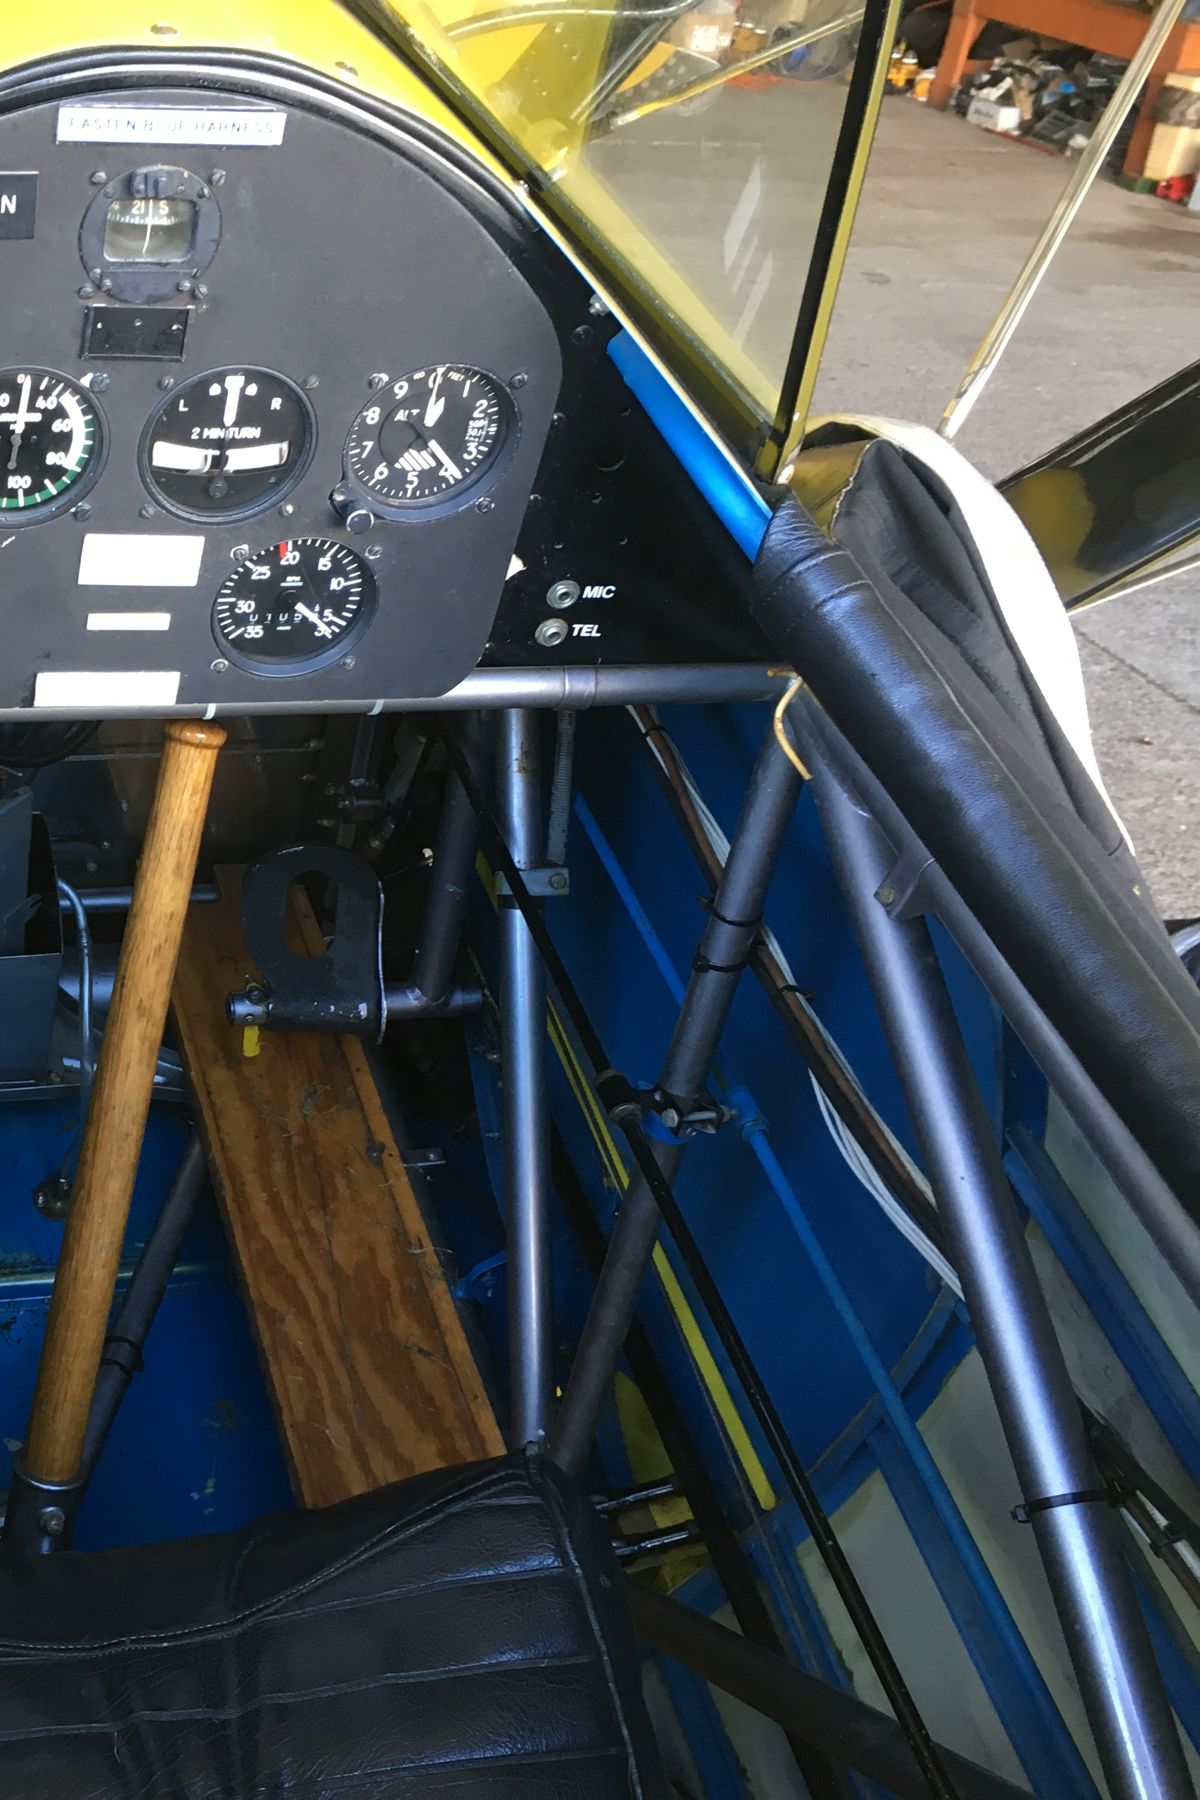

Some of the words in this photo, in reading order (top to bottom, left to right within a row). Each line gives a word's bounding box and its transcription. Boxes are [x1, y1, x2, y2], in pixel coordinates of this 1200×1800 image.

[0, 194, 17, 215] N
[131, 200, 145, 214] 21
[159, 200, 169, 215] S
[393, 380, 409, 399] 9
[462, 379, 471, 398] 1
[35, 395, 58, 410] 40
[178, 398, 189, 412] L
[270, 397, 283, 411] R
[472, 399, 489, 418] 2
[366, 406, 381, 425] 8
[51, 418, 73, 433] 60
[191, 426, 201, 440] 2
[202, 427, 226, 440] MIN
[228, 426, 261, 439] TURN
[361, 440, 375, 459] 7
[462, 442, 478, 460] 3
[374, 462, 389, 480] 6
[7, 475, 32, 489] 100
[404, 471, 419, 489] 5
[280, 551, 300, 565] 20
[317, 557, 332, 571] 15
[251, 565, 271, 580] 25
[330, 577, 345, 590] 10
[582, 585, 617, 599] MIC
[234, 600, 256, 613] 30
[244, 625, 264, 638] 35
[572, 624, 602, 637] TEL
